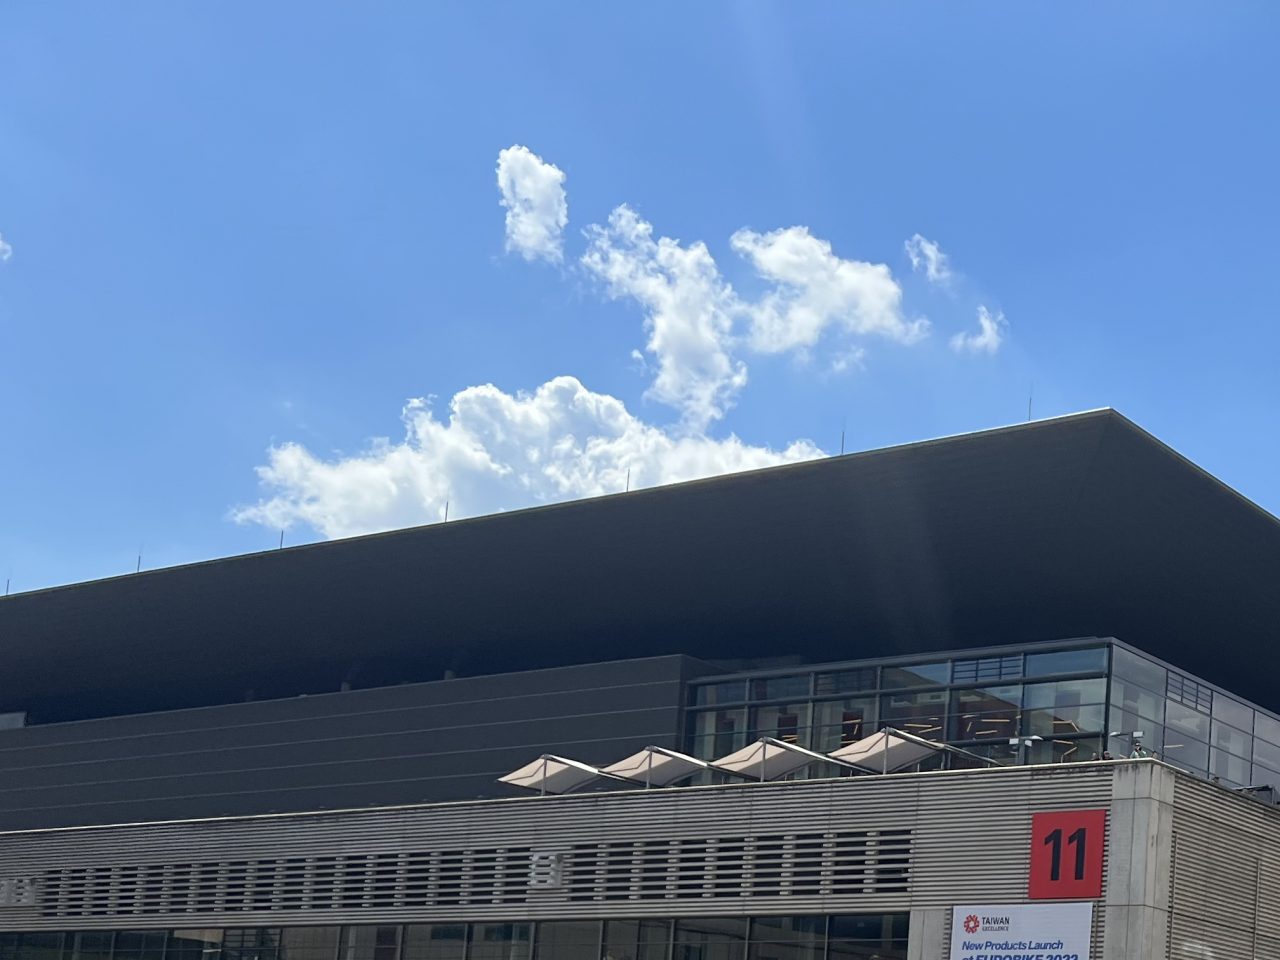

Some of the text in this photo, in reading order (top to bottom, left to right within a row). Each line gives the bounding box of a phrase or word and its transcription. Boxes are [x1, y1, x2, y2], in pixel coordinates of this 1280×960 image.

[1044, 828, 1087, 882] 11
[982, 916, 1010, 925] TAIWAN
[961, 940, 1063, 951] New Products Launch
